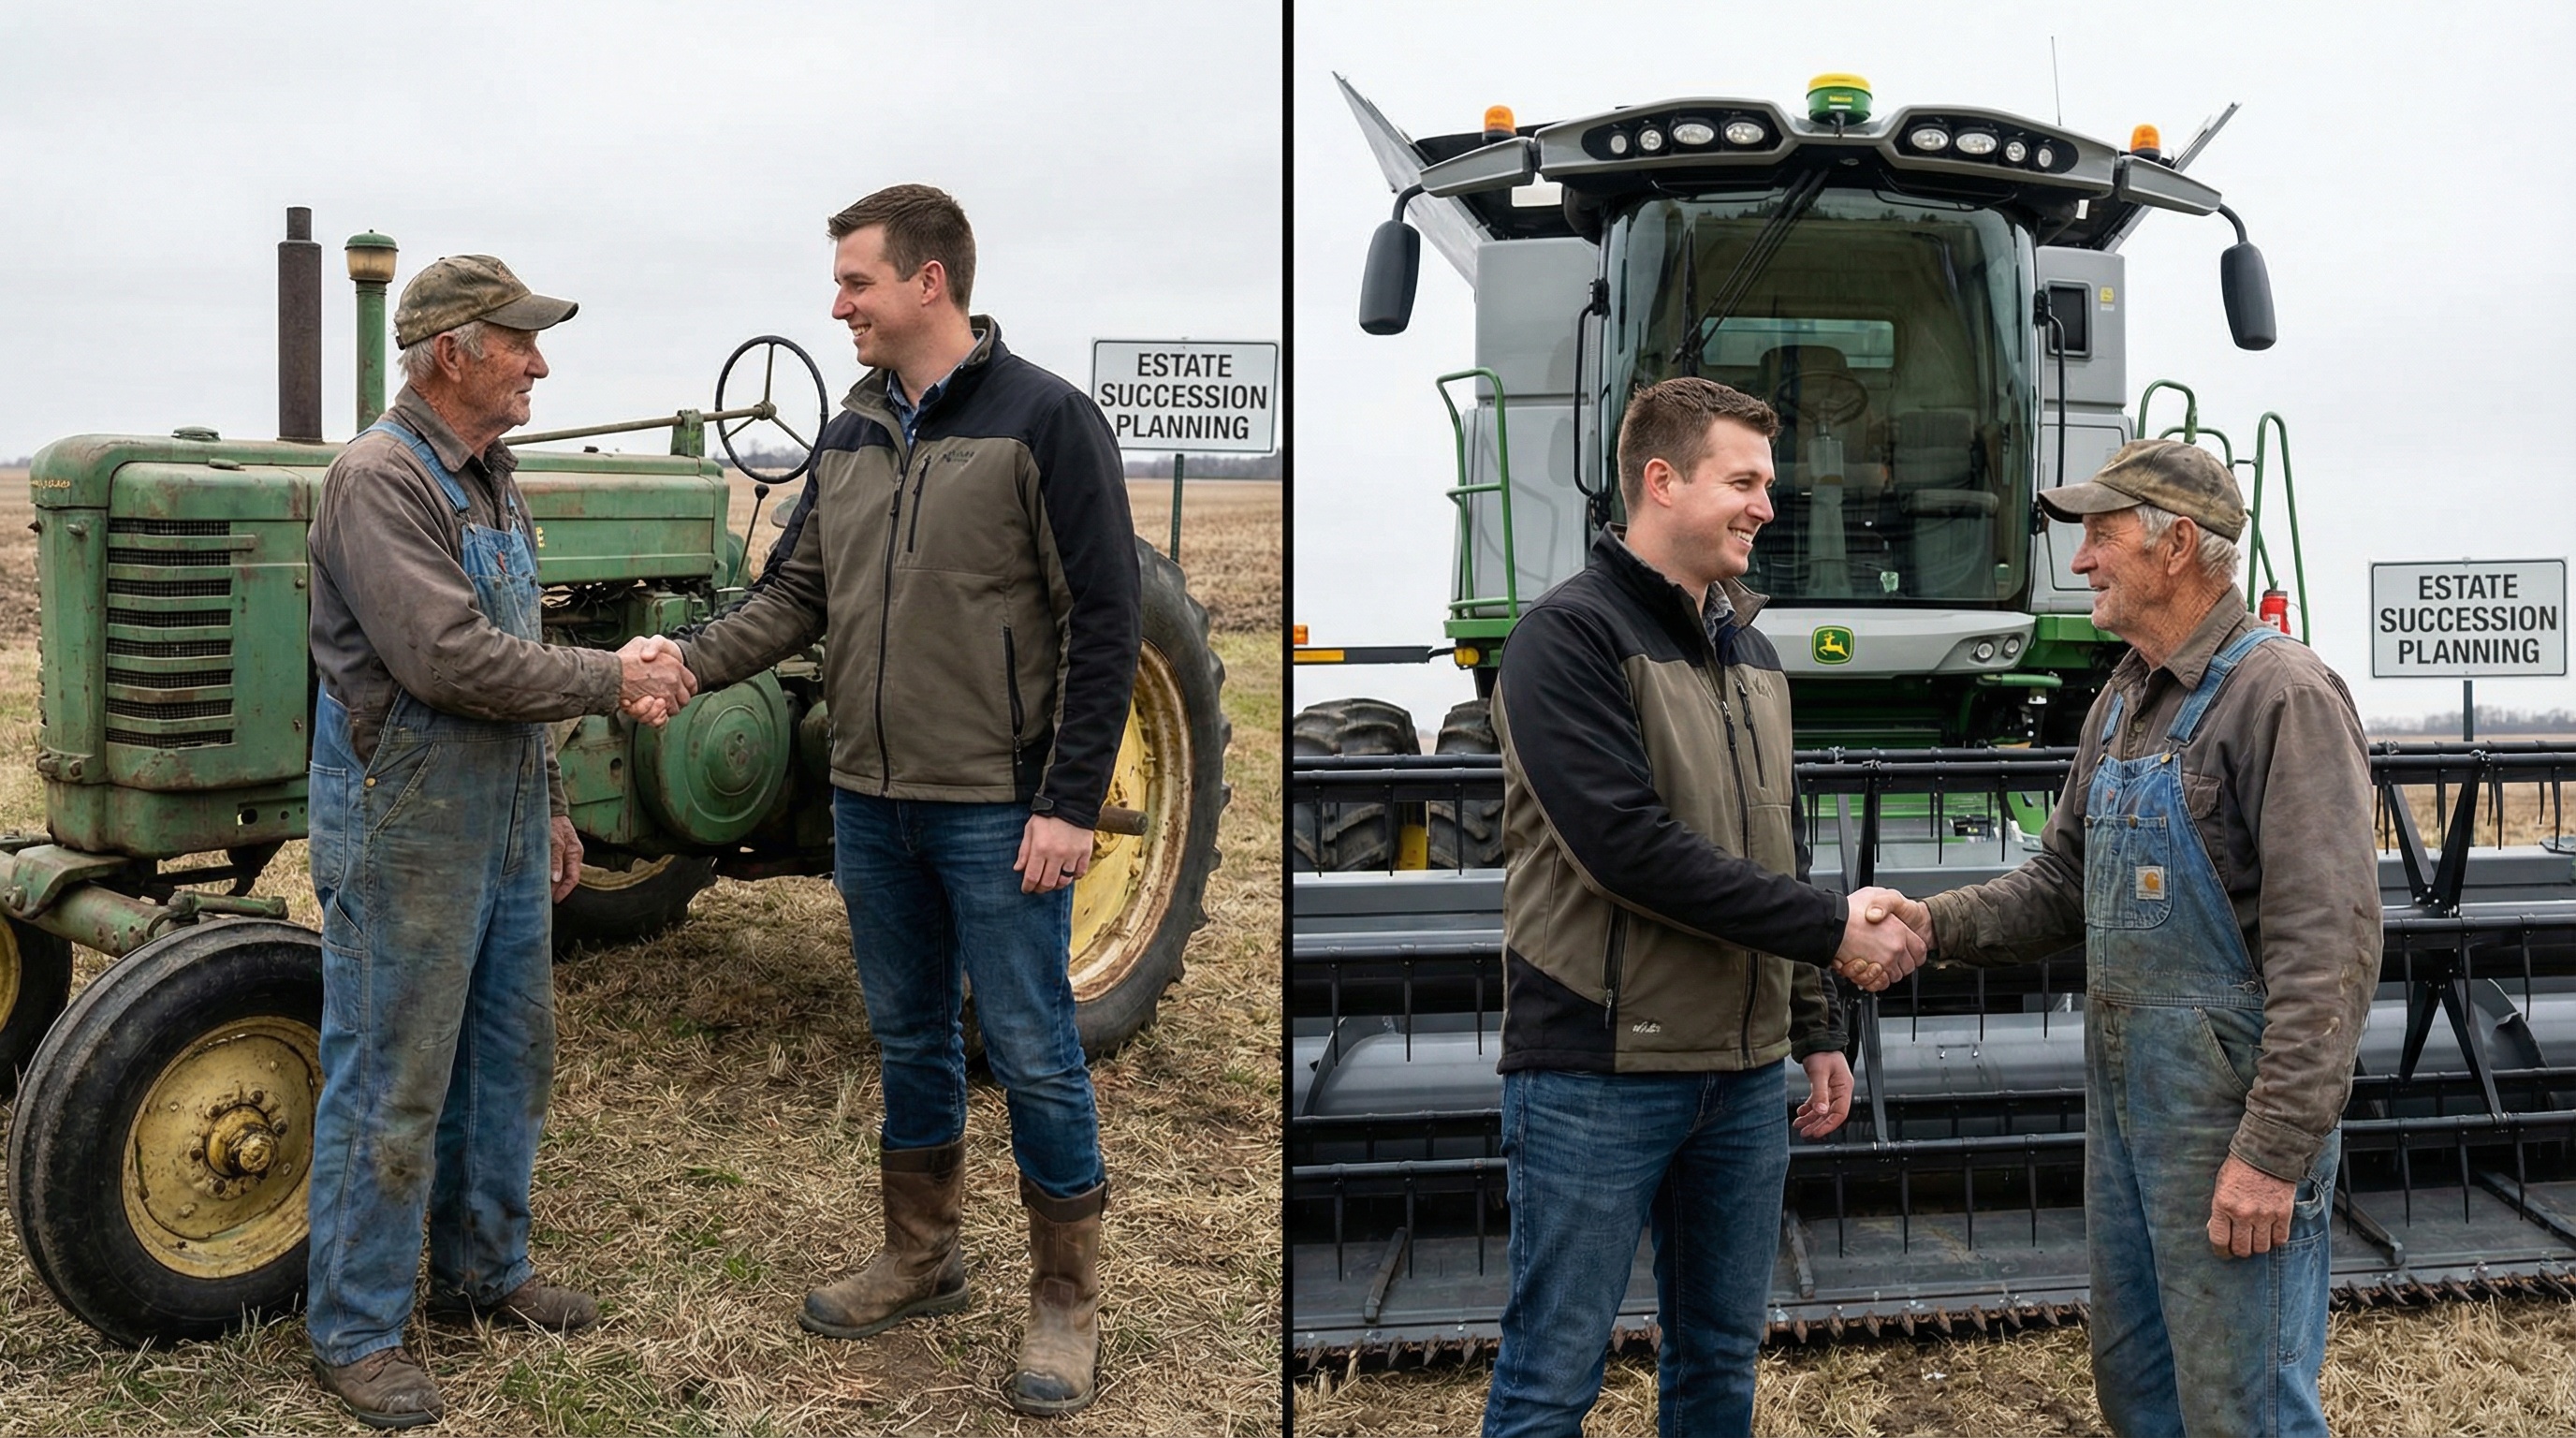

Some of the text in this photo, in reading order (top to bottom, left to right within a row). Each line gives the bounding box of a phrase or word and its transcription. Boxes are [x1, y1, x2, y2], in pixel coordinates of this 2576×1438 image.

[1137, 352, 1232, 377] ESTATE
[1100, 383, 1266, 409] SUCCESSION
[1116, 414, 1249, 439] PLANNING
[2419, 574, 2518, 600] ESTATE
[2380, 606, 2556, 633] SUCCESSION
[2398, 638, 2539, 664] PLANNING
